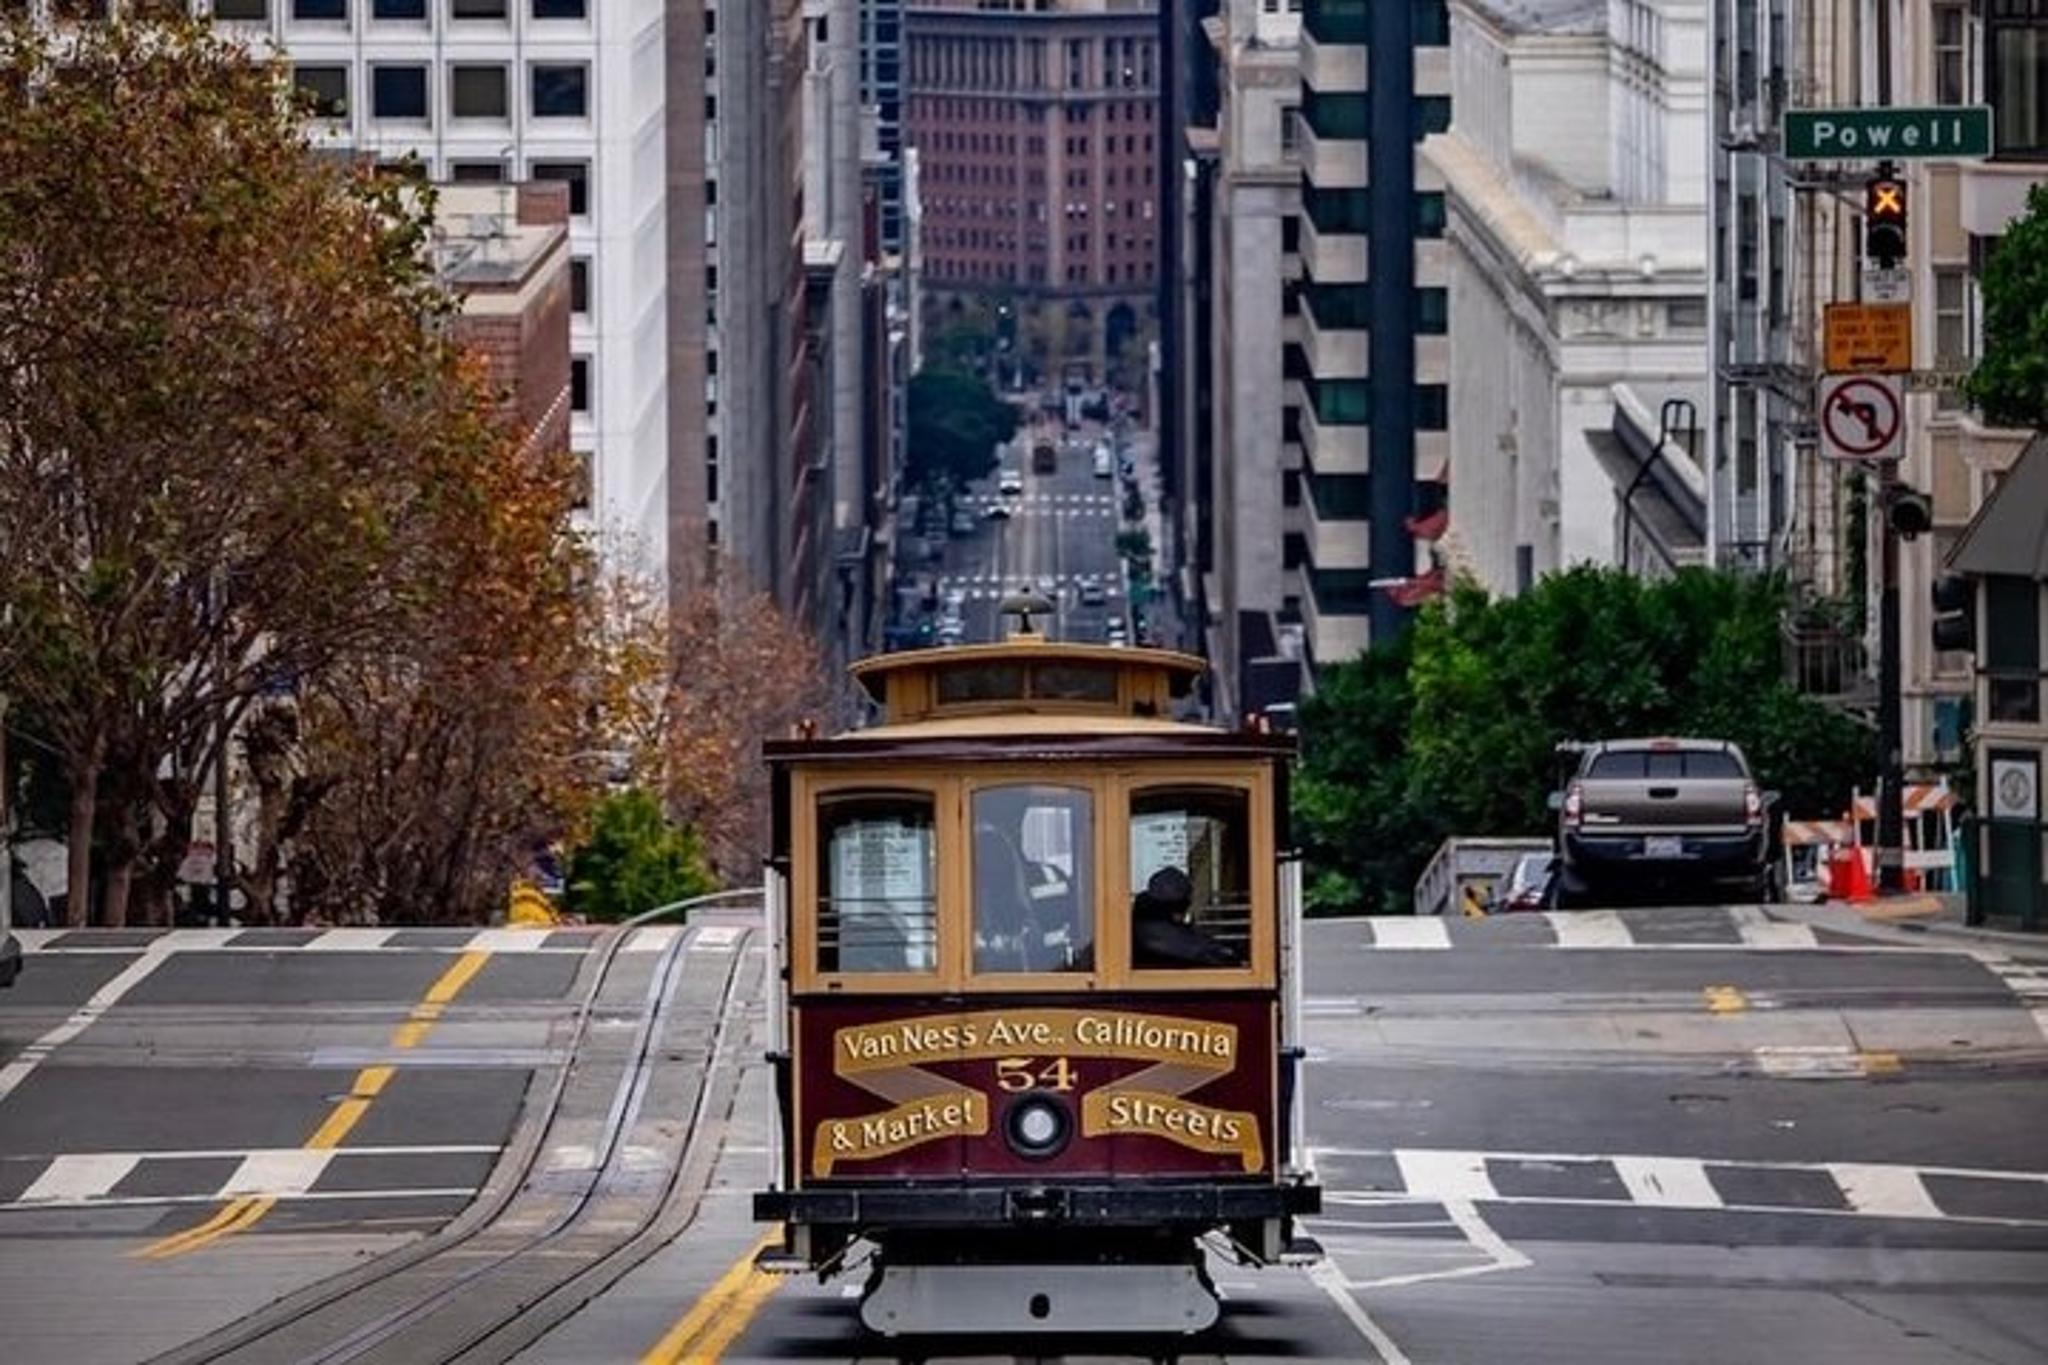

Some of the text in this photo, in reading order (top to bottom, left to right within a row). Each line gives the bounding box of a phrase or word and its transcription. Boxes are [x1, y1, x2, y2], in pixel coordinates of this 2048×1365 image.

[1813, 121, 1962, 147] Powell
[844, 1031, 897, 1059] Van
[899, 1023, 977, 1052] Ness
[1076, 1017, 1231, 1056] California
[995, 1056, 1080, 1092] 54
[832, 1098, 974, 1150] & Market
[1108, 1096, 1241, 1141] Streets
